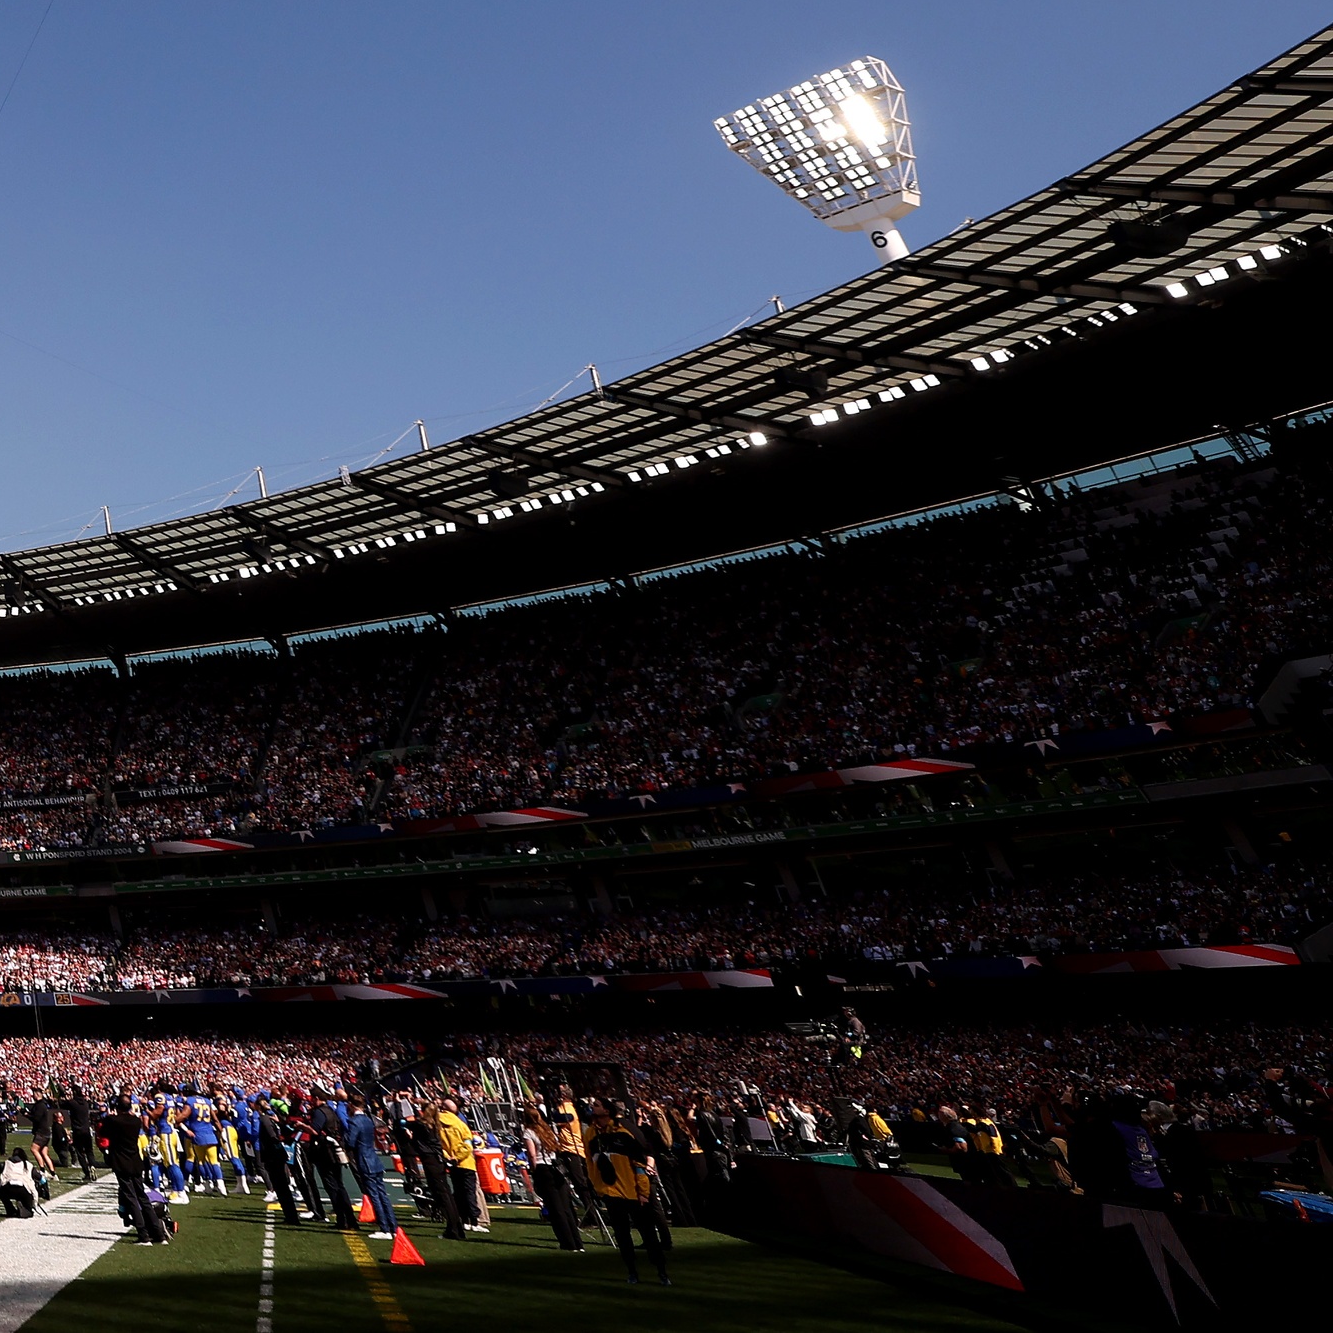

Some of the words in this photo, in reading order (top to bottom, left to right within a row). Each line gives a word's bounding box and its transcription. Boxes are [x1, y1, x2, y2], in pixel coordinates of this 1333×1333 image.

[871, 230, 888, 248] 6
[692, 835, 754, 848] MELBOURNE
[754, 831, 786, 842] GAME
[35, 852, 42, 860] H
[43, 850, 86, 859] PONSFORD
[87, 848, 113, 857] STAND
[113, 847, 132, 855] 2004
[23, 888, 47, 896] GAME
[23, 994, 32, 1006] 0
[56, 994, 70, 1004] 25
[193, 1102, 210, 1123] 73
[490, 1158, 505, 1181] G
